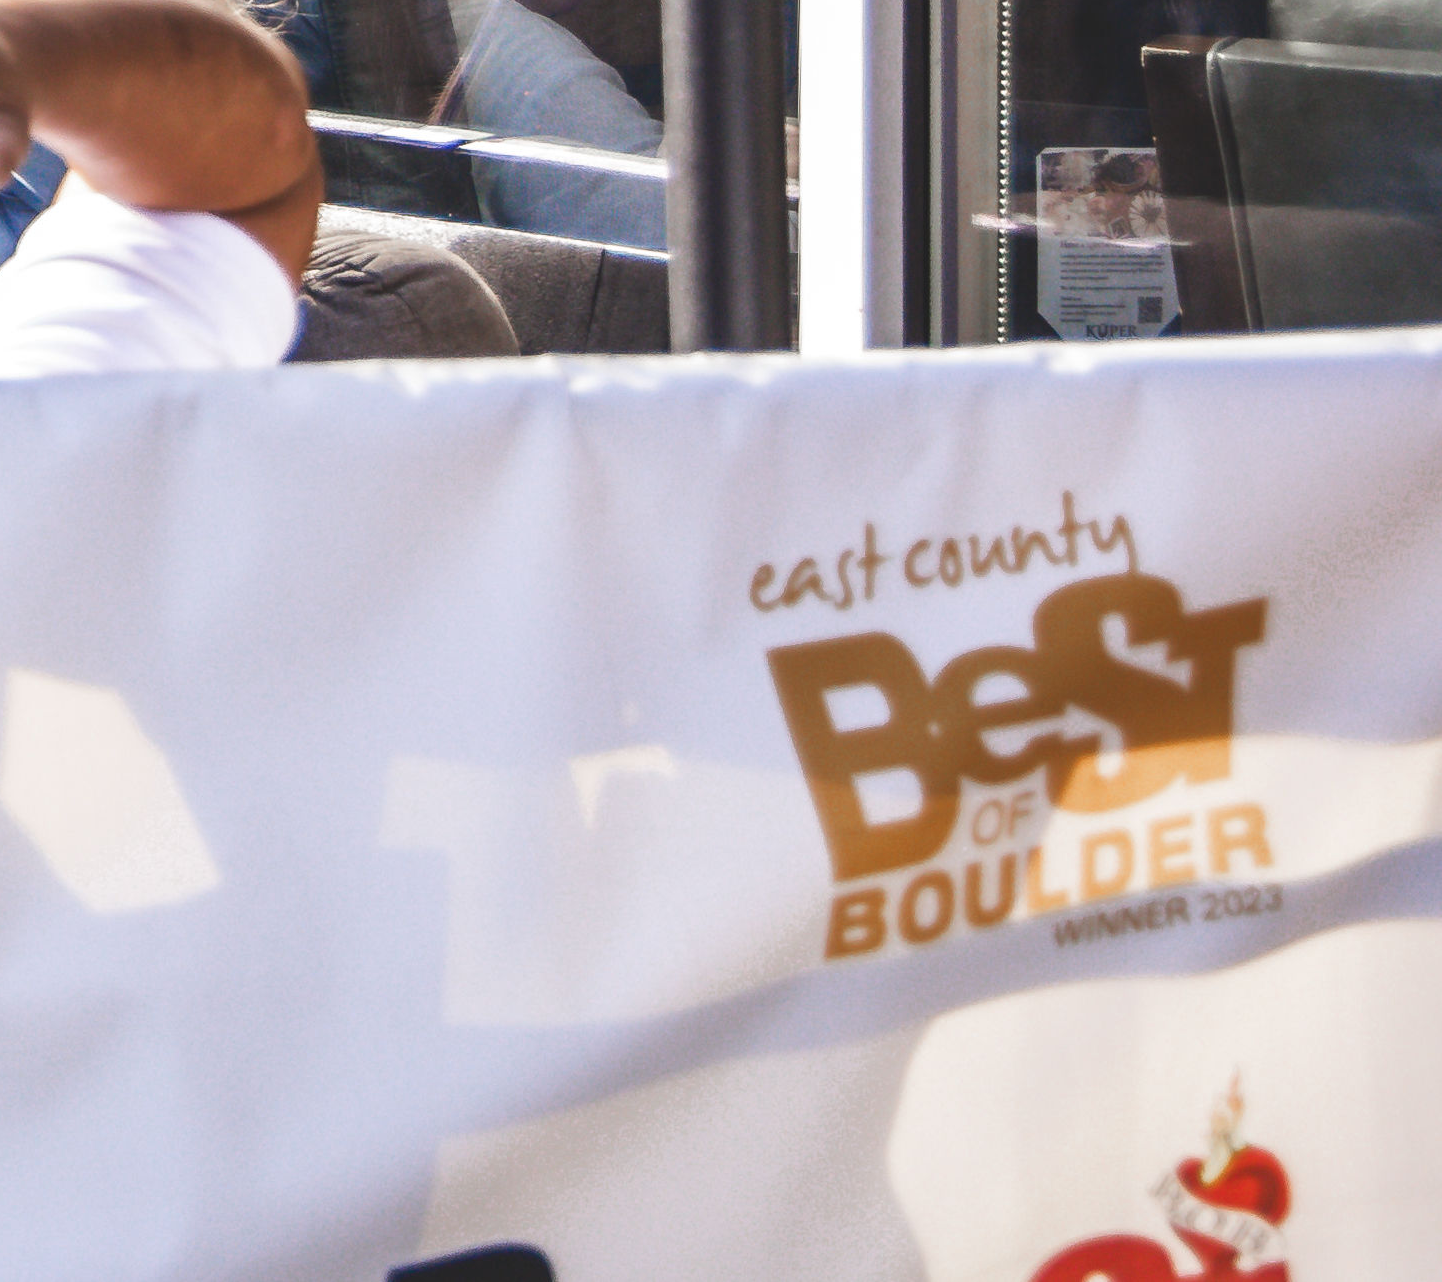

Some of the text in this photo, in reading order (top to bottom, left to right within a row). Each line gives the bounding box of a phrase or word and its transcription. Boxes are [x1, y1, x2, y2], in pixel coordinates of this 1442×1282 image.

[747, 490, 1141, 612] east county
[970, 790, 1035, 848] OF
[823, 801, 1275, 962] BOULDER
[1051, 883, 1285, 948] WINNER 2023
